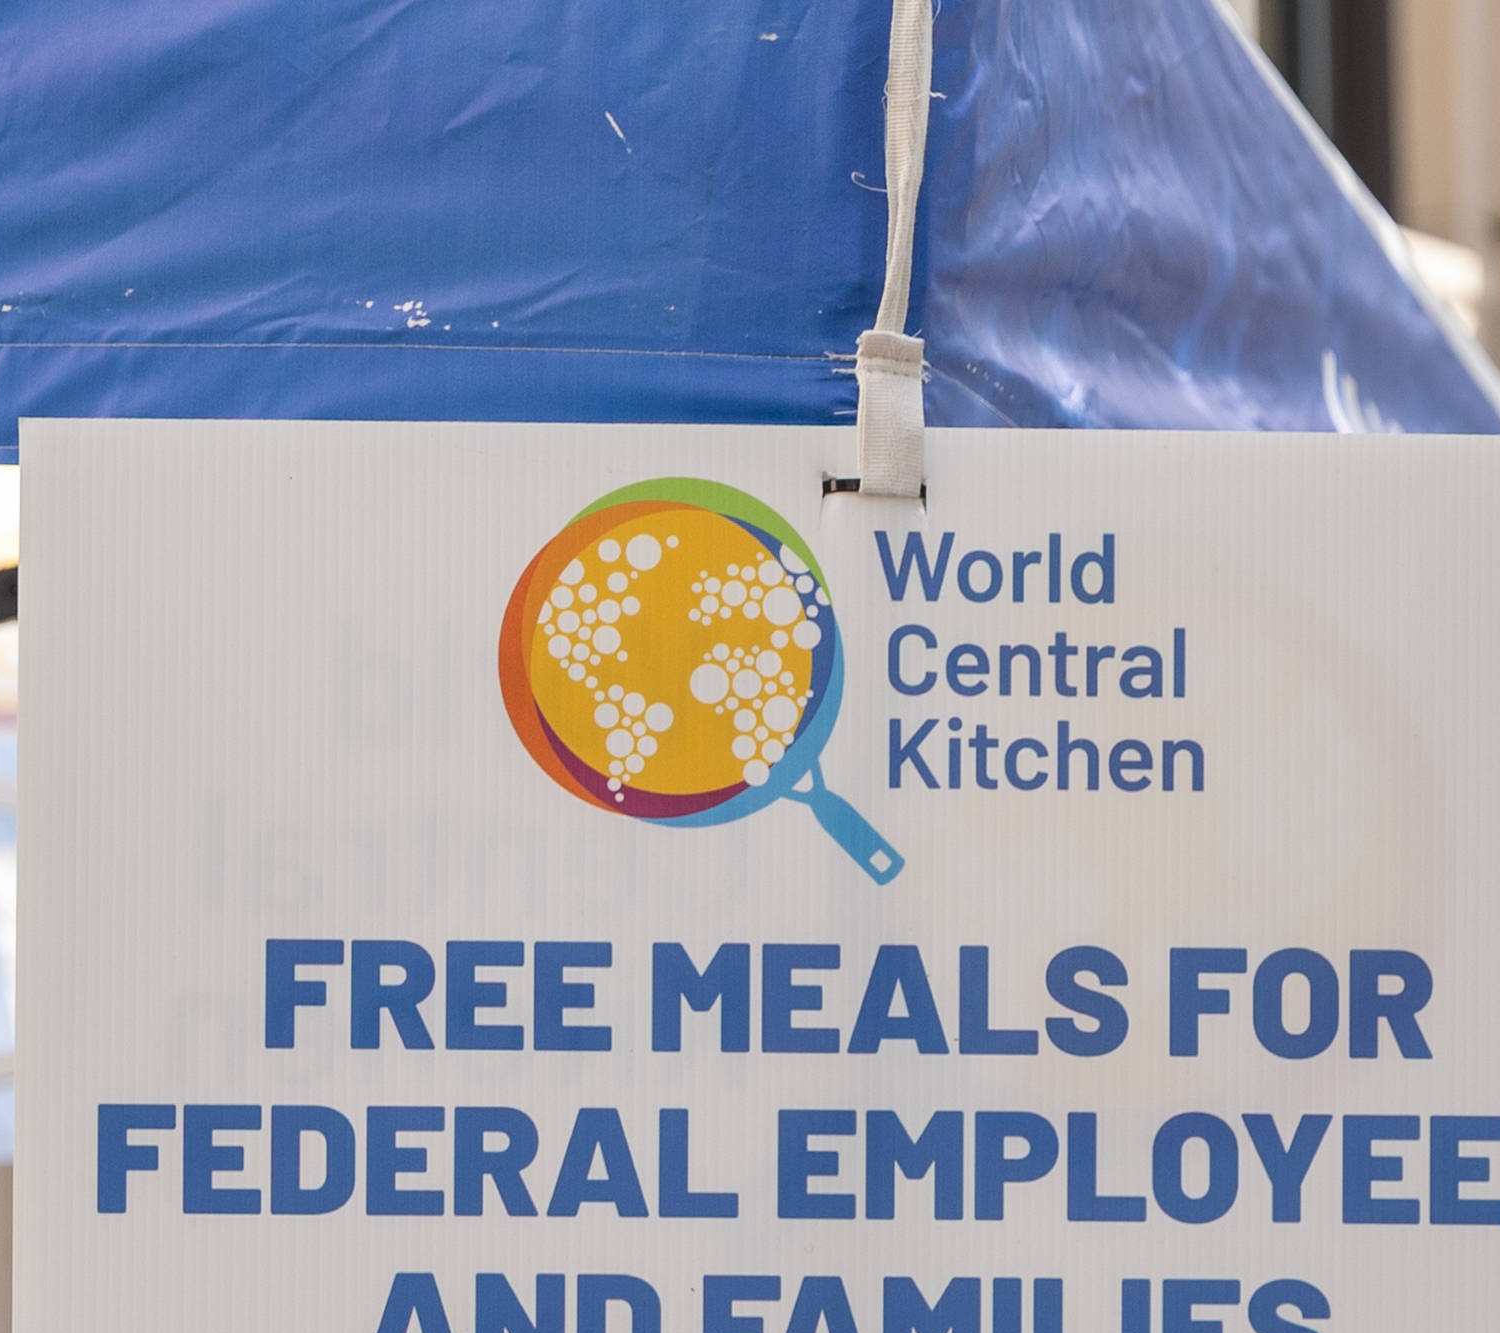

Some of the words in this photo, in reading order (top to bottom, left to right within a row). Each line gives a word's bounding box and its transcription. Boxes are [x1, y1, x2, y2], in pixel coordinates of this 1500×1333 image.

[875, 531, 1115, 603] World
[888, 625, 1186, 698] Central
[888, 718, 1205, 792] Kitchen
[264, 938, 613, 1052] FREE
[650, 942, 1129, 1057] MEALS
[1169, 947, 1434, 1060] FOR
[96, 1103, 739, 1220] FEDERAL
